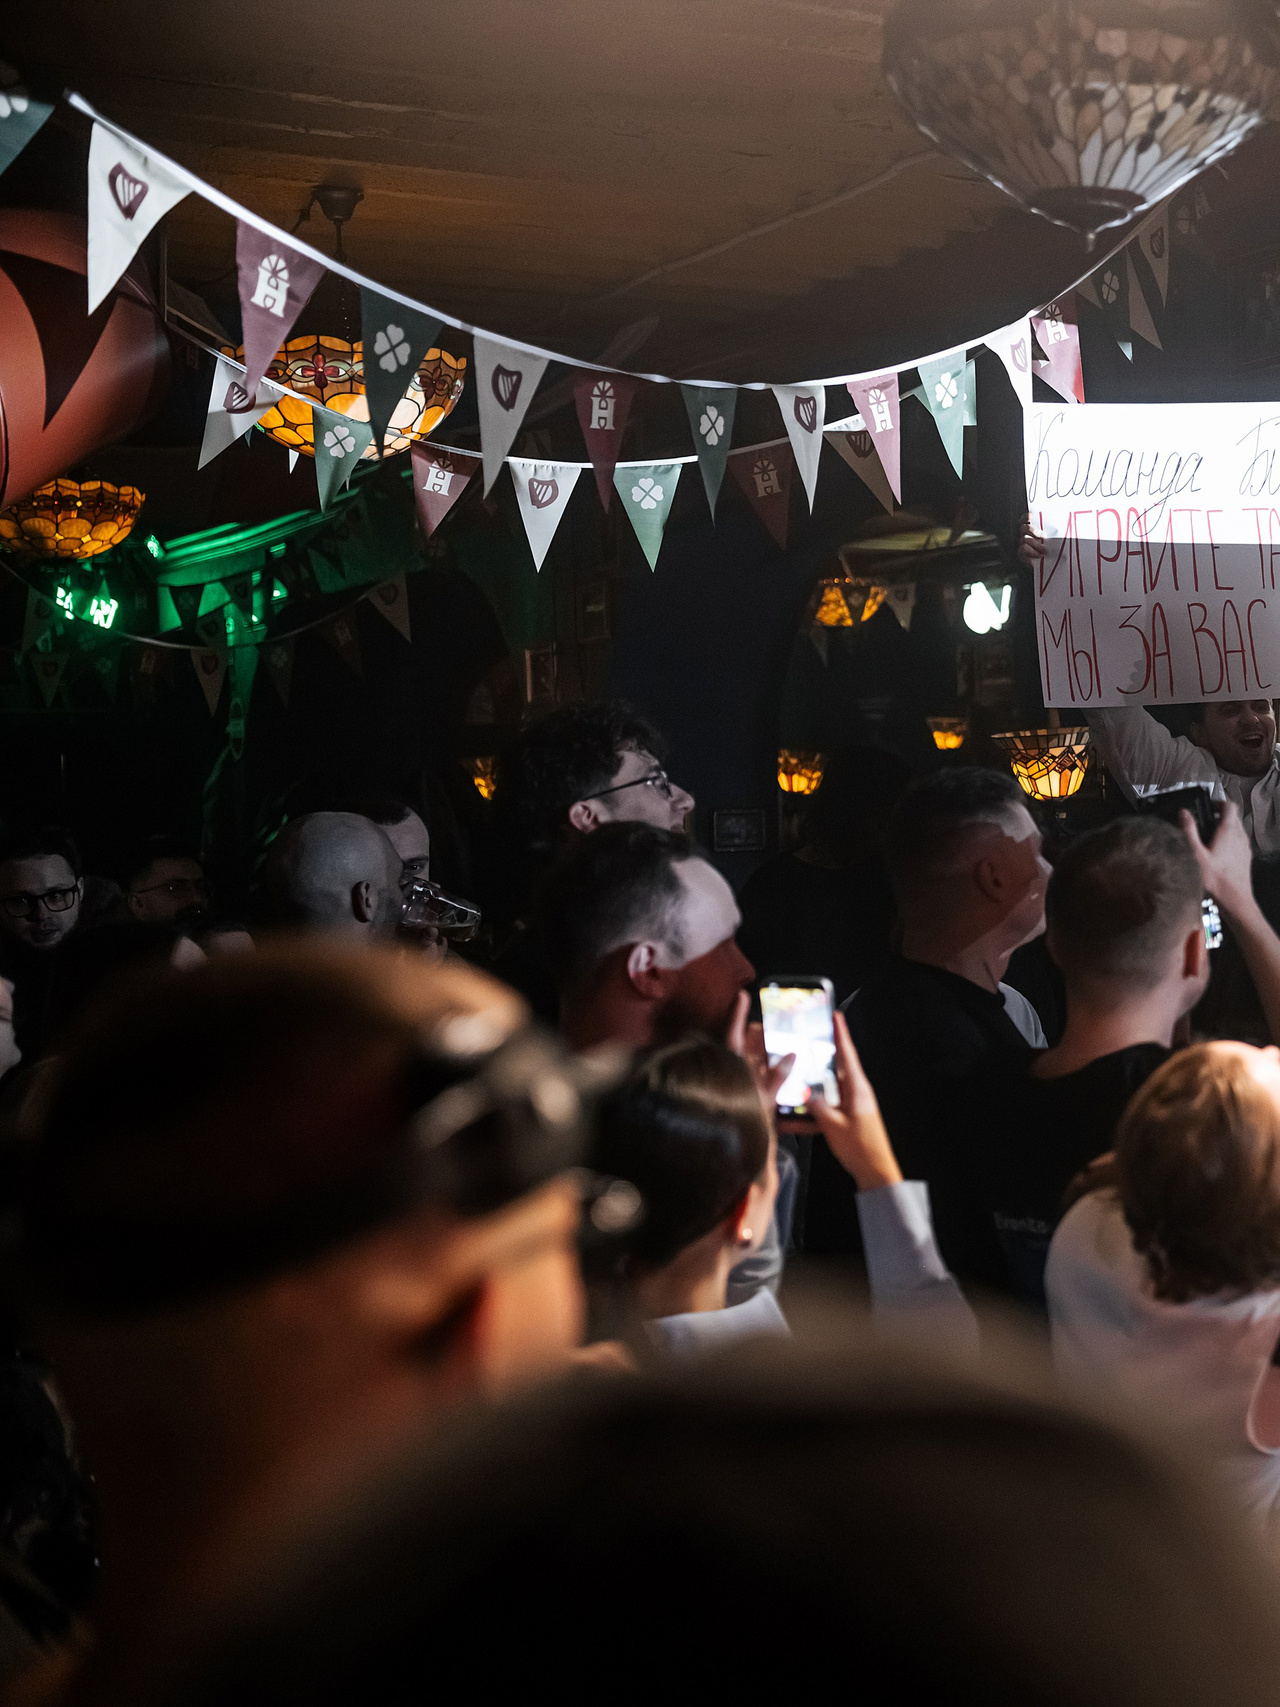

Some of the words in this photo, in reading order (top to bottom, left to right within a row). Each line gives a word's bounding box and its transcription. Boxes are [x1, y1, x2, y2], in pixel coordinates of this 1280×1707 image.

[1029, 410, 1204, 537] Команда
[1041, 607, 1102, 702] МЫ
[1115, 601, 1174, 699] ЗА
[1186, 599, 1273, 698] ВАС
